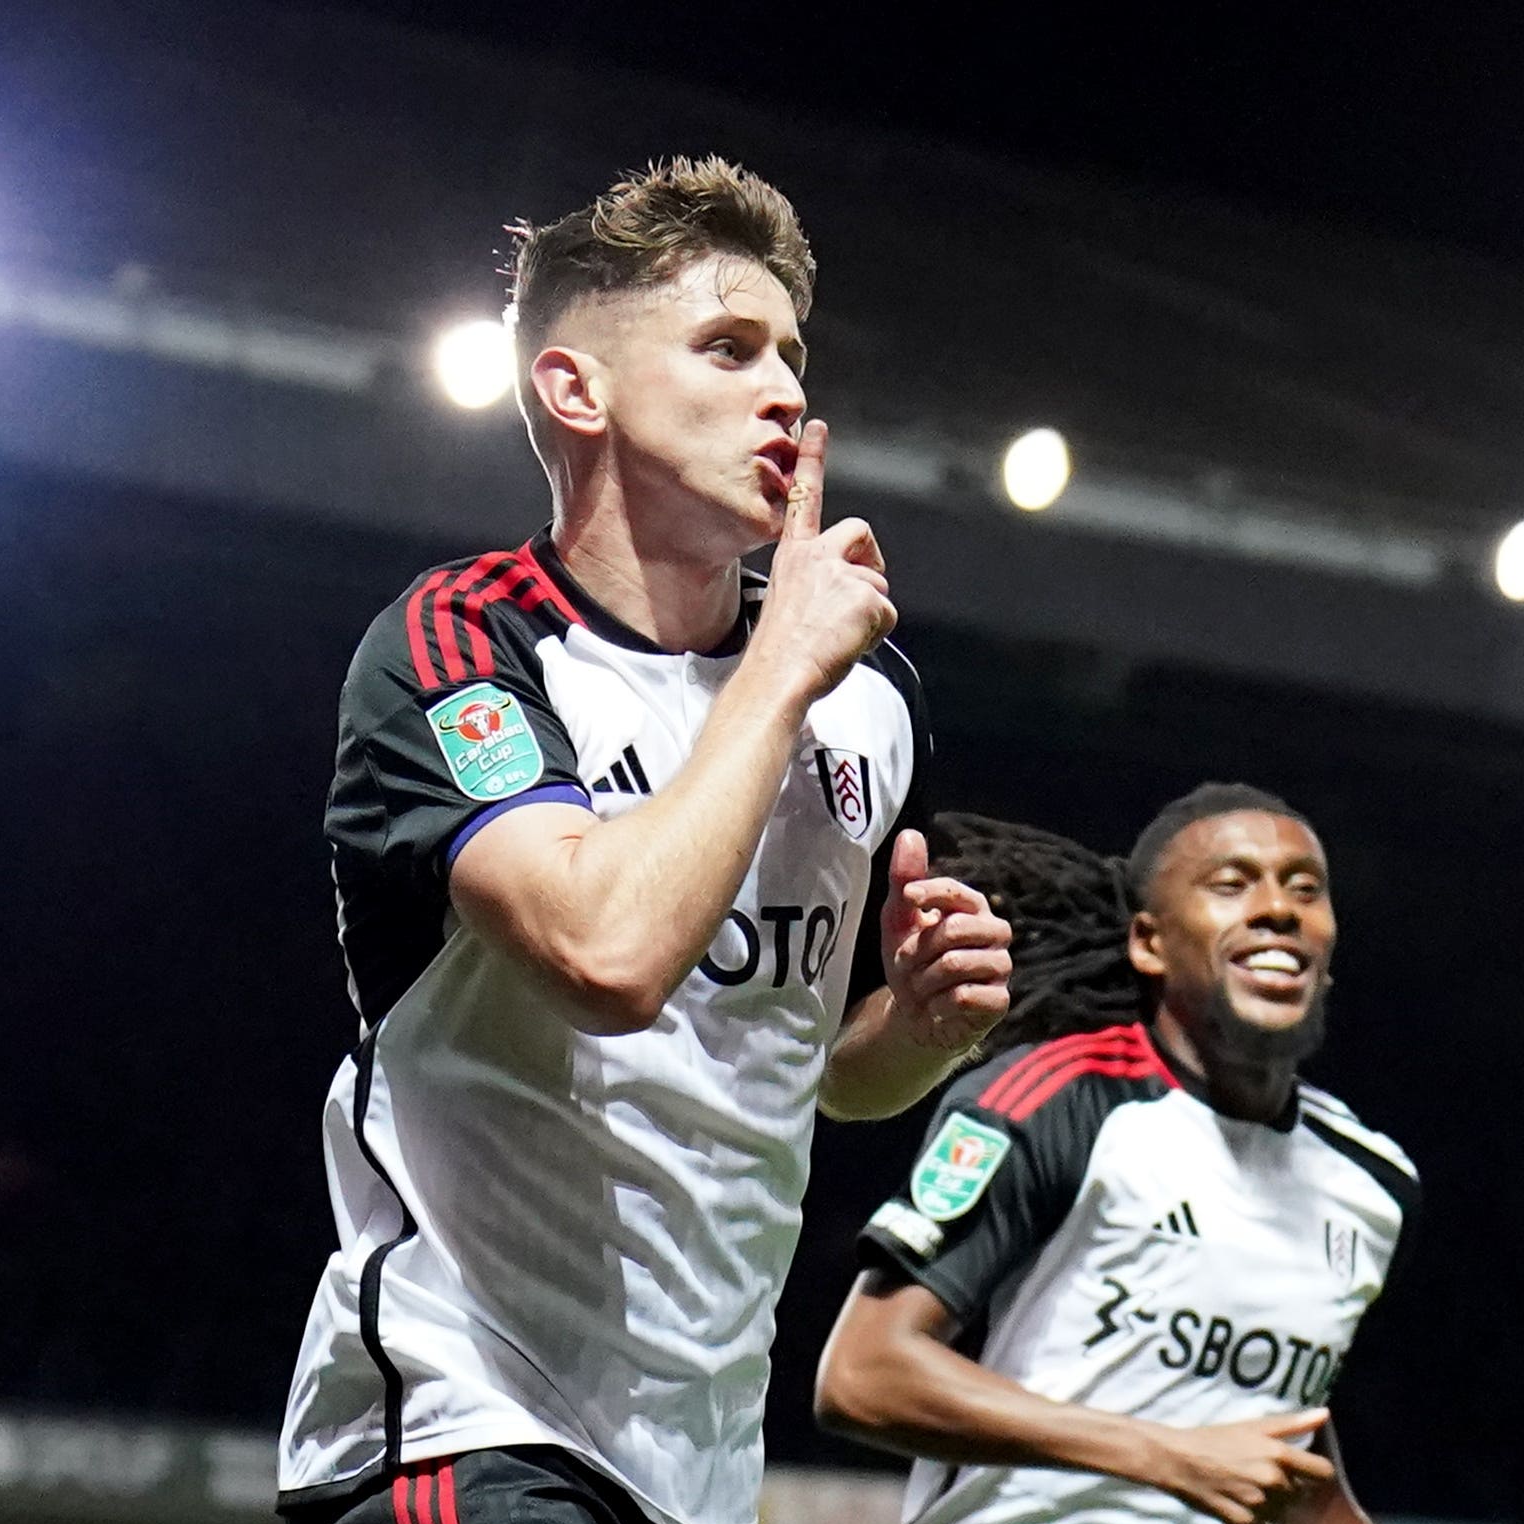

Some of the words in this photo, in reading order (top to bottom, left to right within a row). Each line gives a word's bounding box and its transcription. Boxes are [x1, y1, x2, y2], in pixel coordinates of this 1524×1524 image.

[455, 723, 524, 772] Carabao
[477, 743, 514, 772] Cup
[698, 900, 848, 989] OTO
[1159, 1308, 1336, 1404] SBOTO
